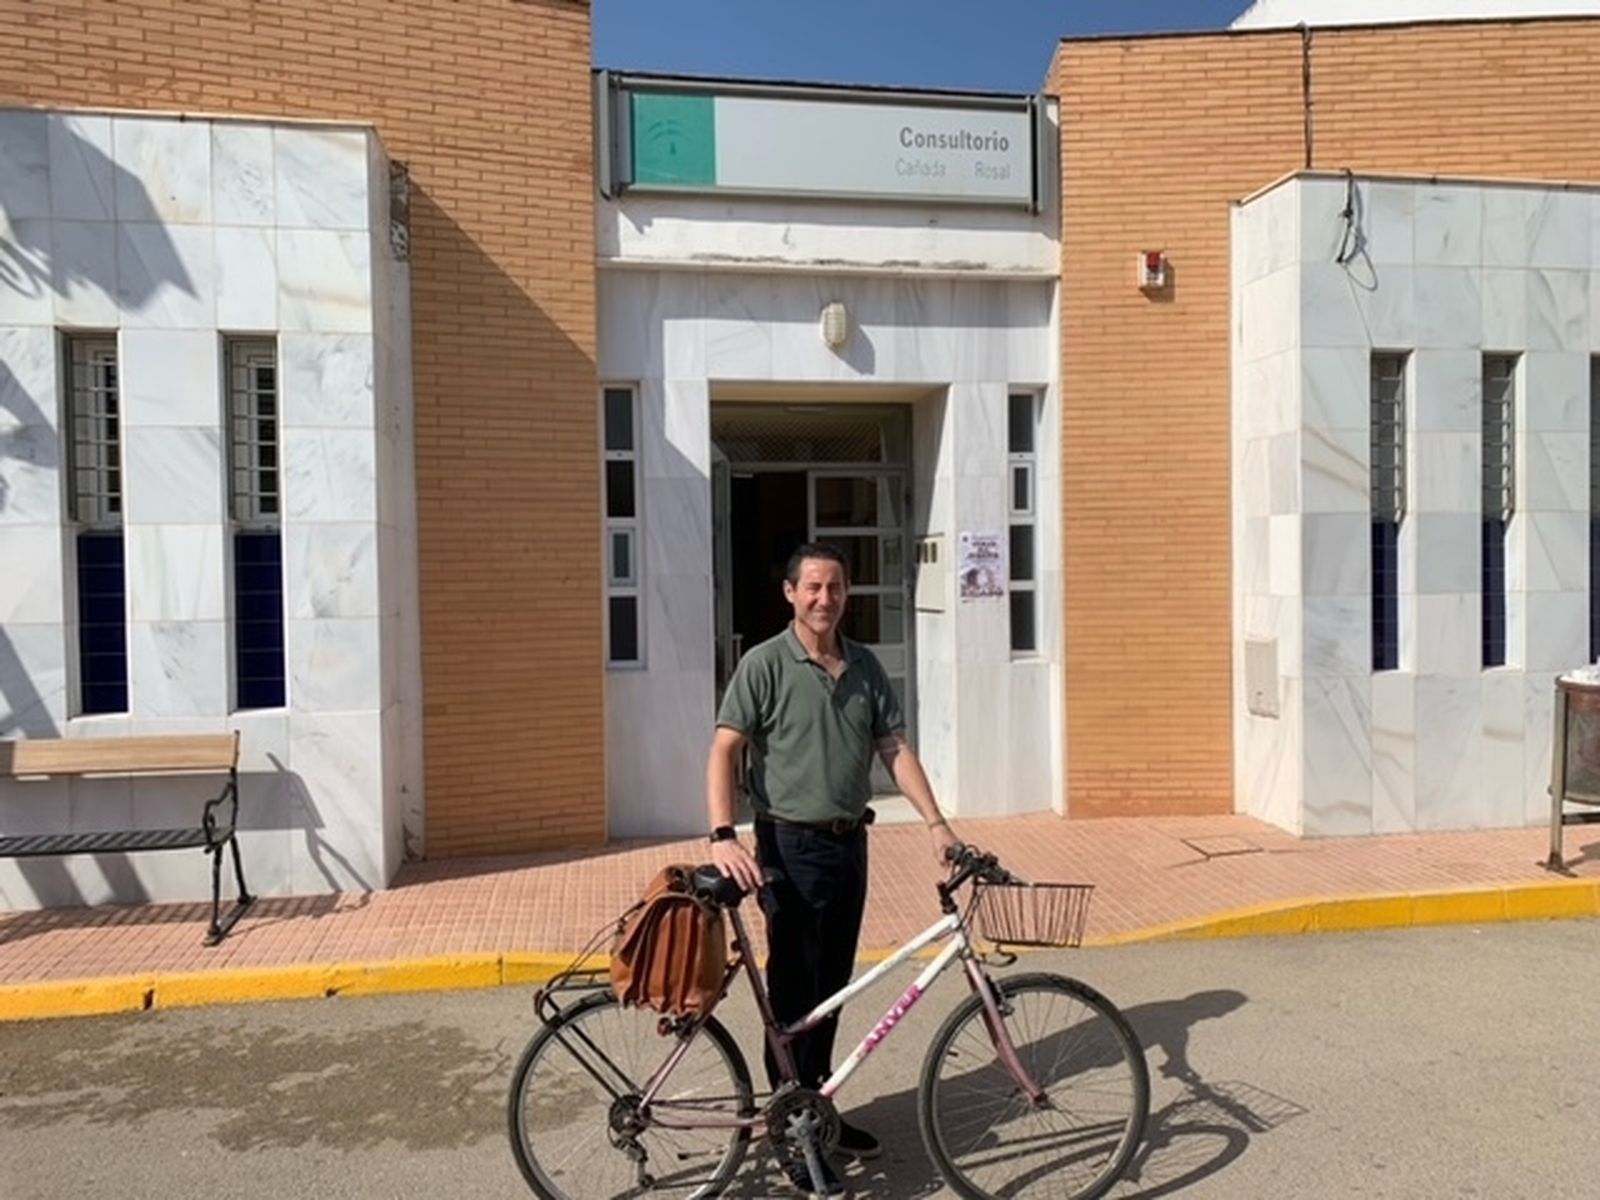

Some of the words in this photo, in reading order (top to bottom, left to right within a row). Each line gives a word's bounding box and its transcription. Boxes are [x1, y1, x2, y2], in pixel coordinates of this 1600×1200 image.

[900, 126, 1010, 152] Consultorio
[894, 157, 947, 178] Cañada
[975, 161, 1012, 181] Rosal
